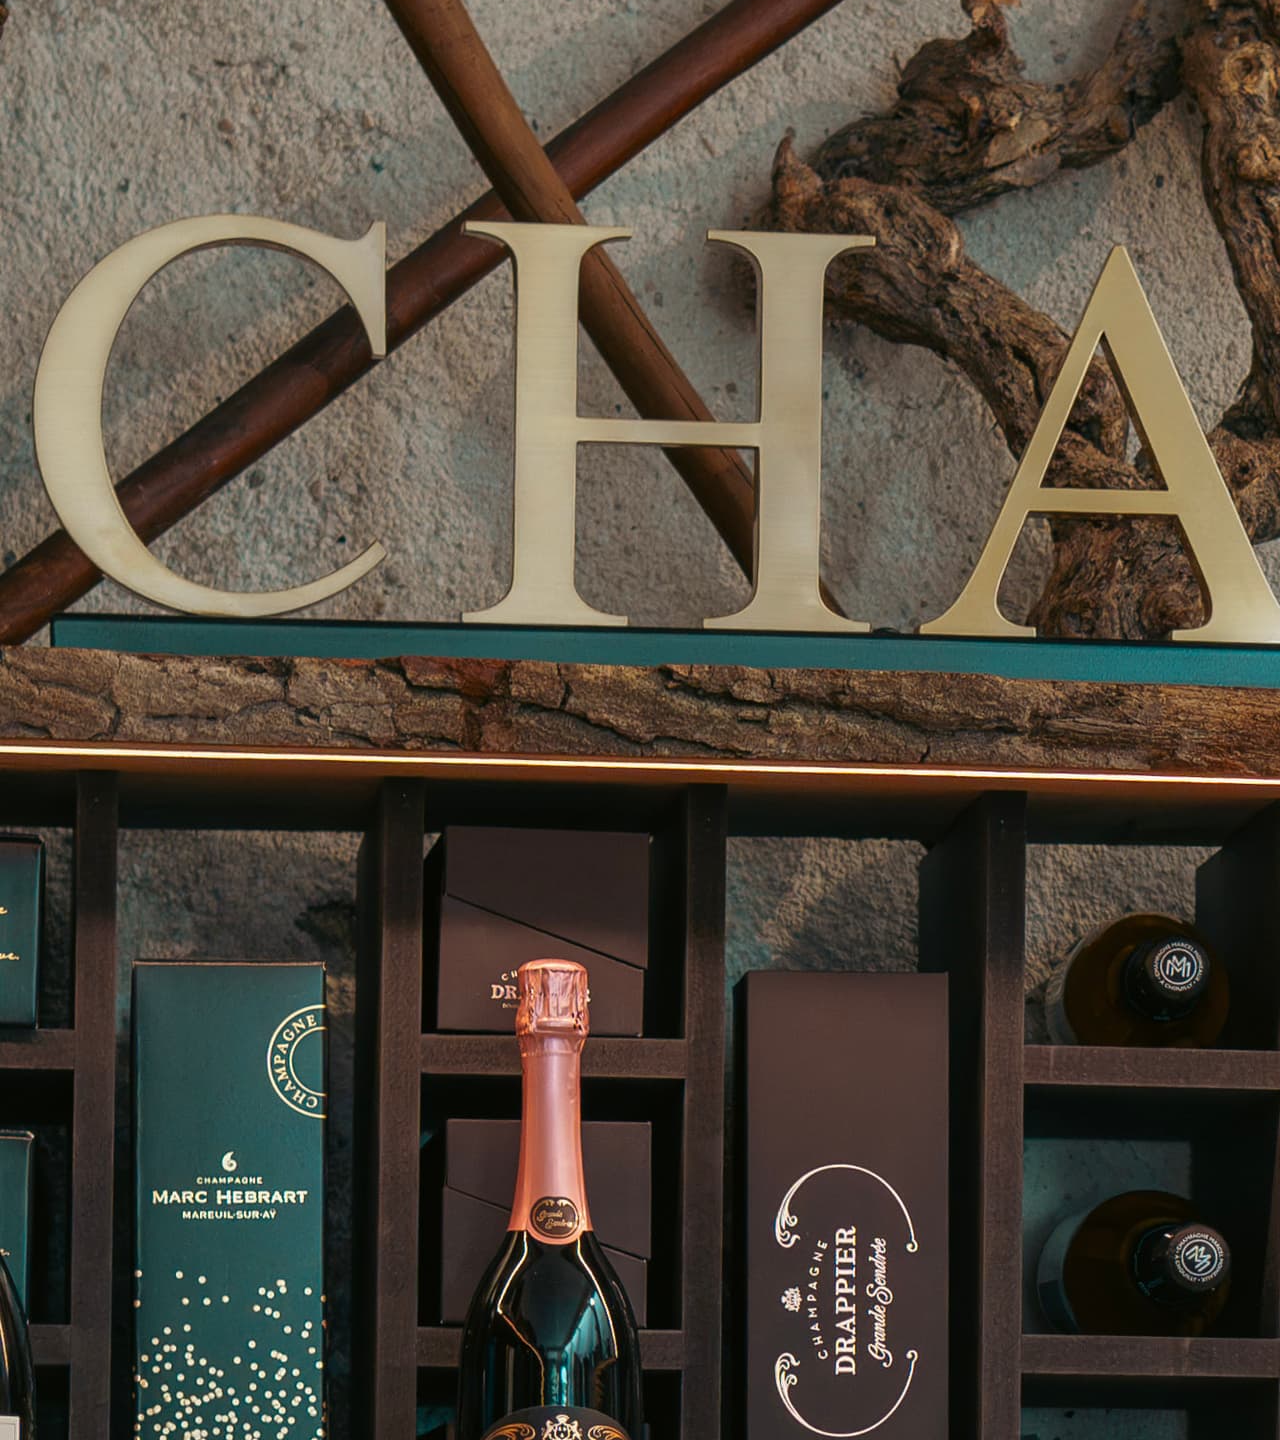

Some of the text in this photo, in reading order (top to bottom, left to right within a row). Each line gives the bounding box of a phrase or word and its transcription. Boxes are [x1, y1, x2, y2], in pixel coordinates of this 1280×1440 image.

[274, 1014, 319, 1109] CHAMPAGNE
[152, 1190, 308, 1204] MARC HEBRART
[807, 1240, 828, 1359] CHAMPAGNE
[835, 1226, 856, 1375] DRAPPIER
